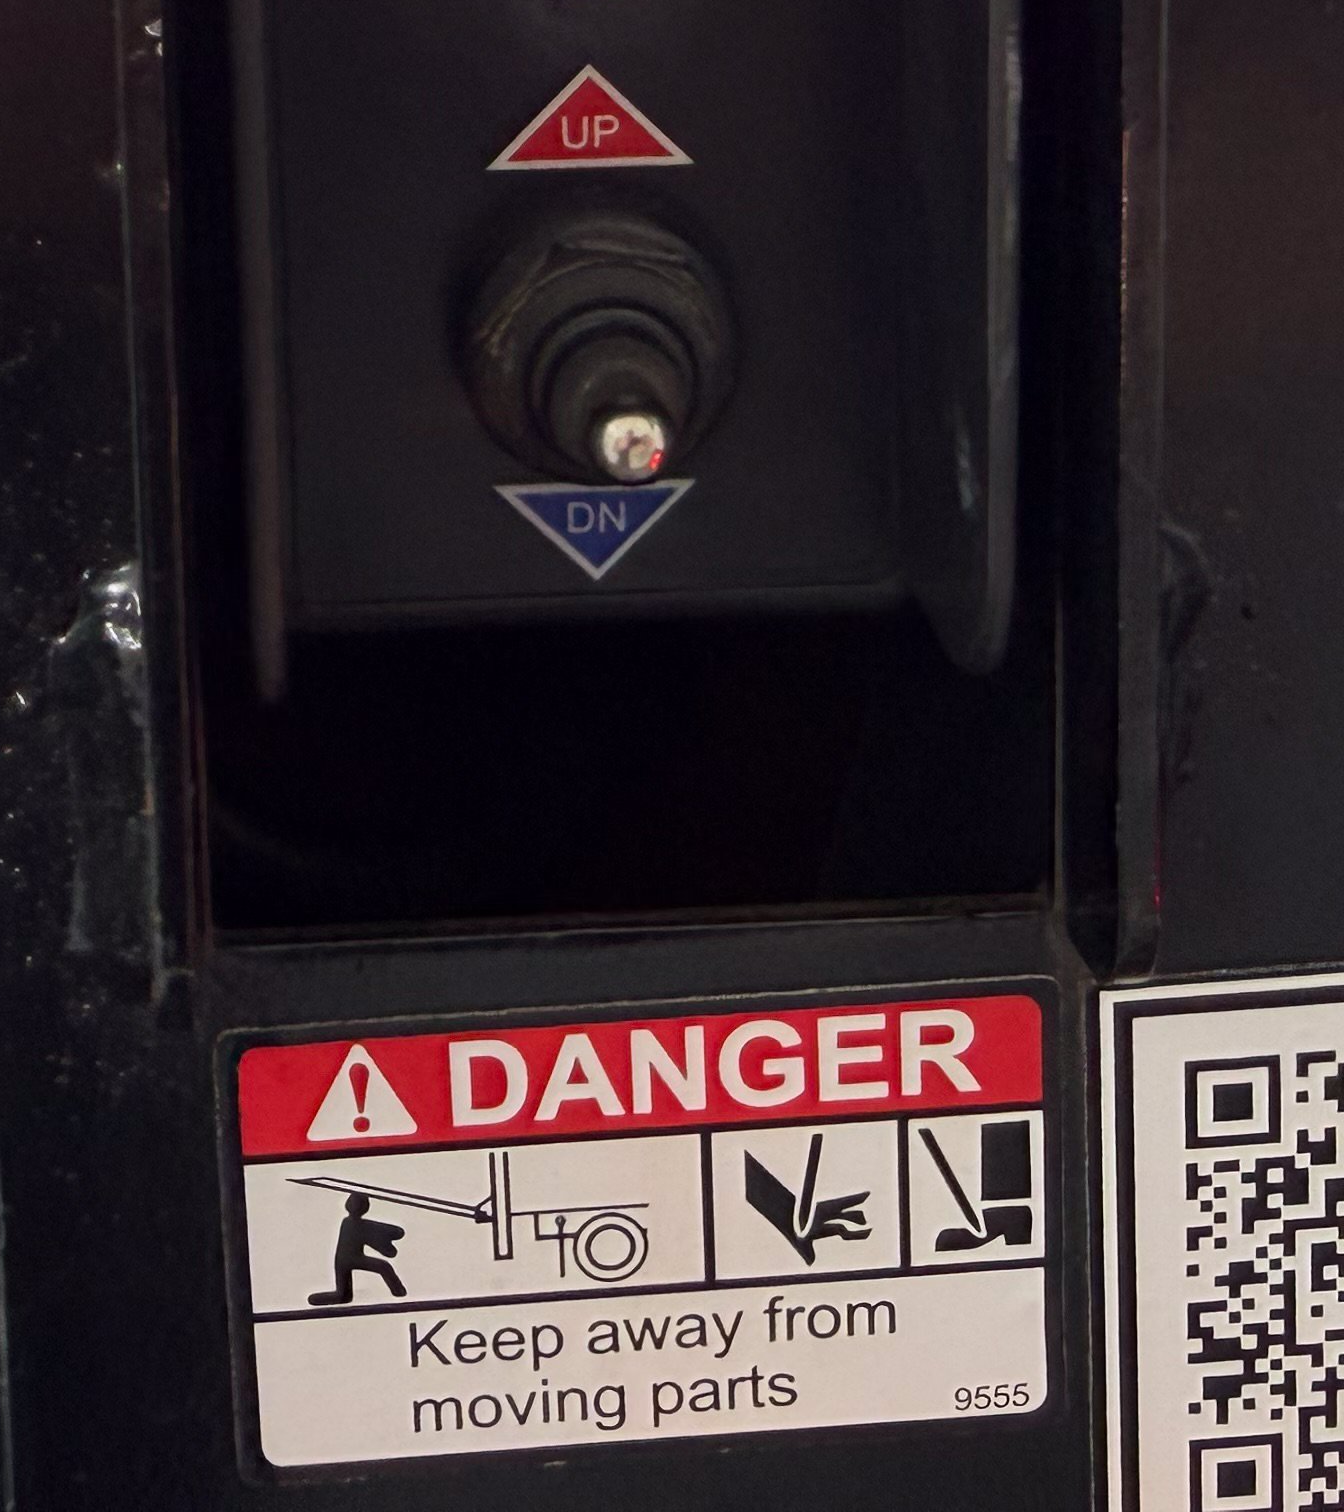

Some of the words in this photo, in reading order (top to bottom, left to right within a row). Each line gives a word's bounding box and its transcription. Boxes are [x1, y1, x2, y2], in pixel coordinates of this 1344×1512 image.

[561, 114, 620, 149] UP
[567, 501, 626, 534] DN
[448, 1007, 981, 1127] DANGER
[409, 1320, 564, 1371] Keep
[587, 1304, 744, 1358] away
[763, 1296, 897, 1343] from
[413, 1375, 627, 1431] moving
[653, 1365, 799, 1419] parts
[953, 1382, 1031, 1412] 9555
